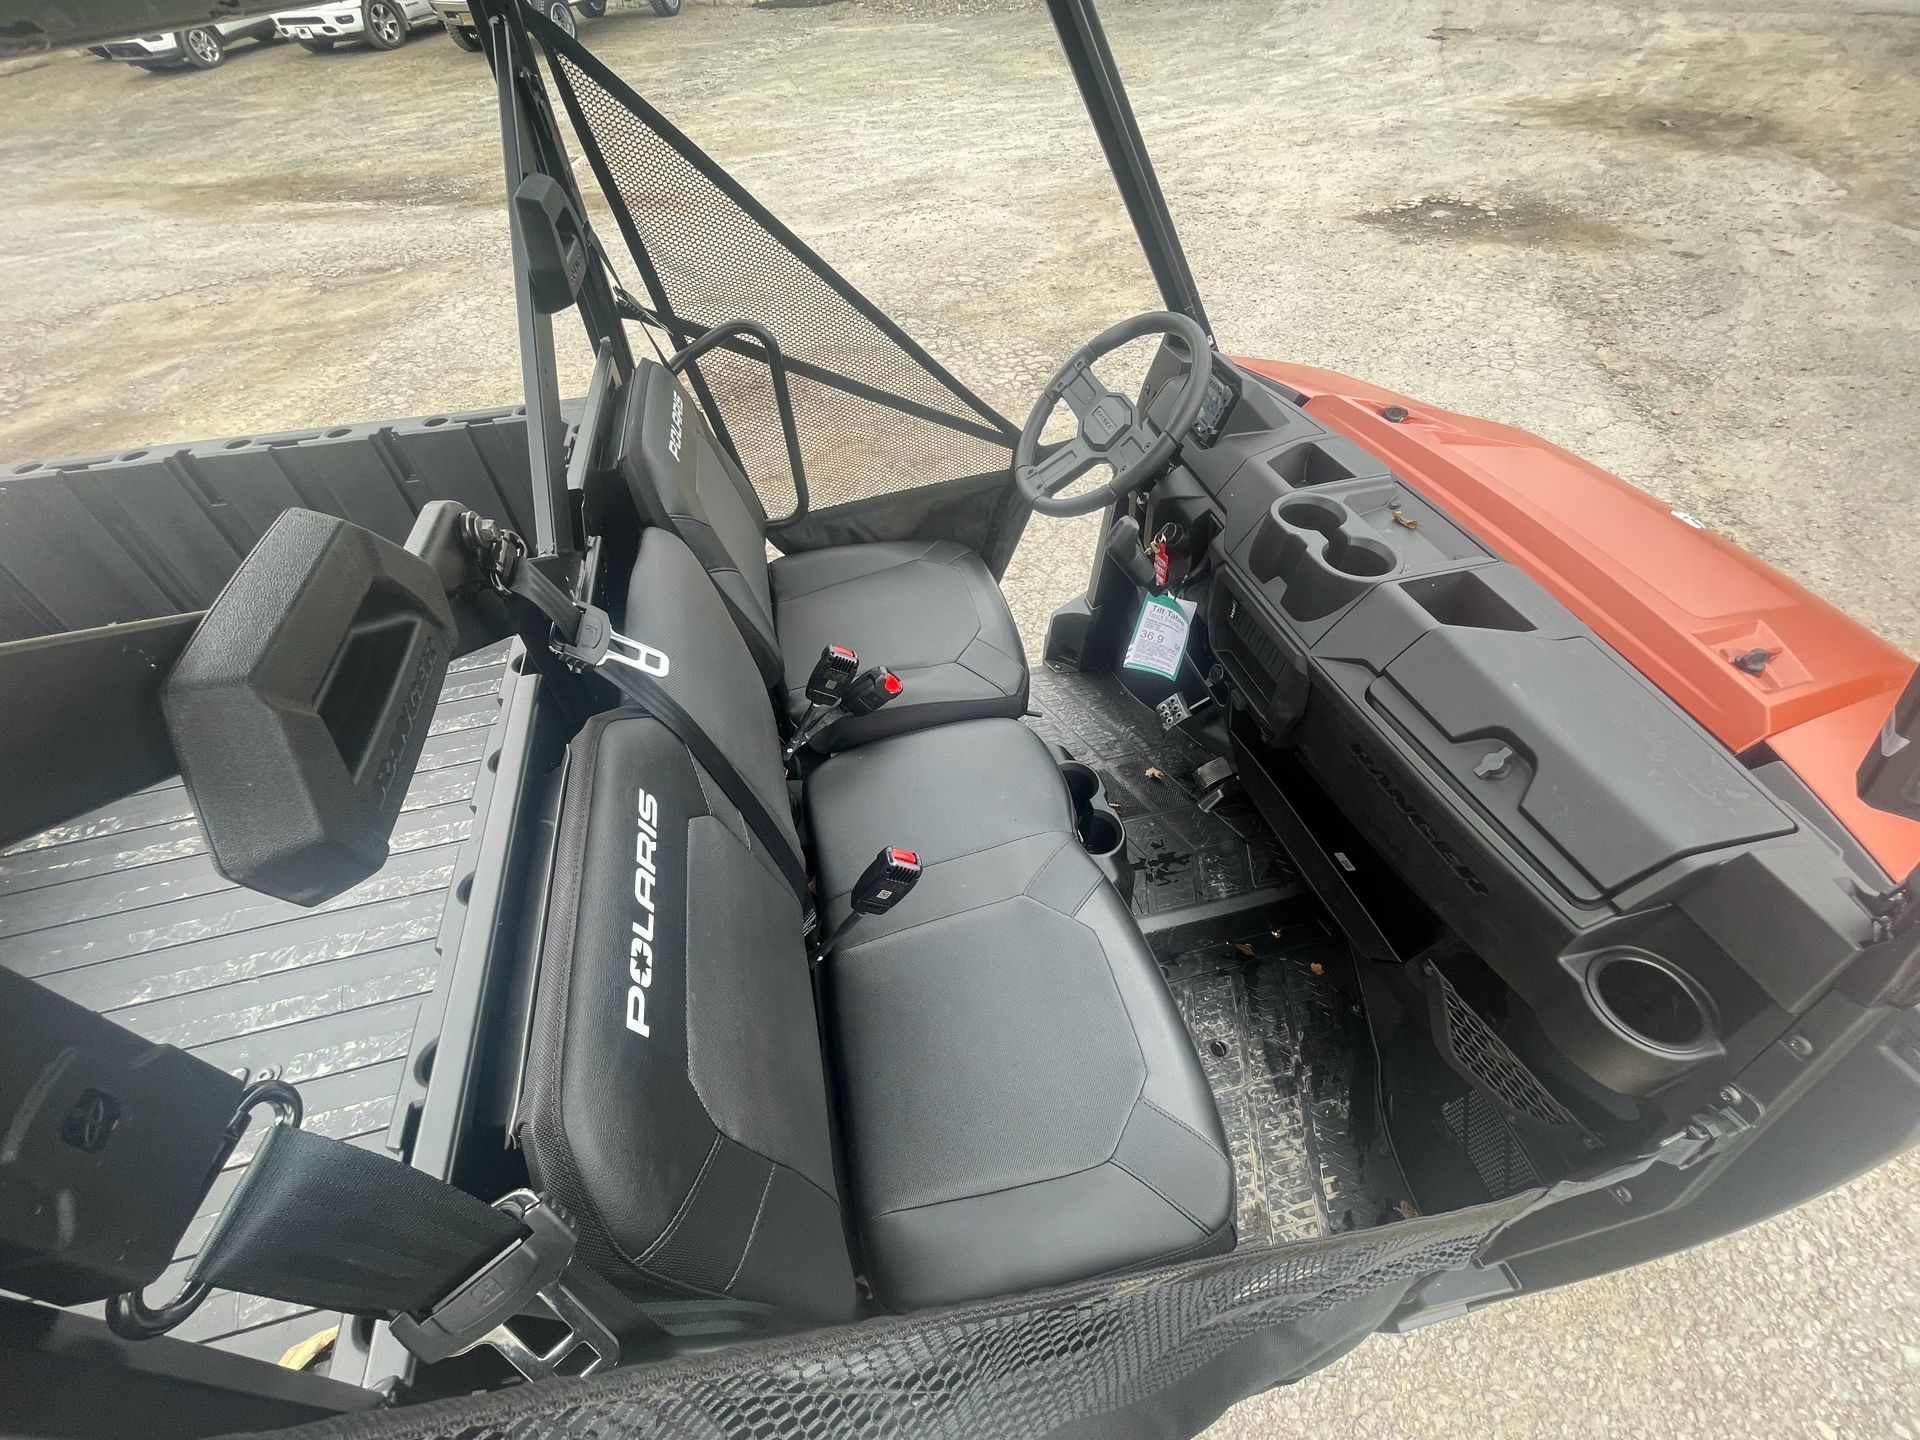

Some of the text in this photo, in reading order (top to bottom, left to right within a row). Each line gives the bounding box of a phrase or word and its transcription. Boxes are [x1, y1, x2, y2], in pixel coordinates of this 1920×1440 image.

[668, 390, 684, 463] POLARIS
[1140, 629, 1164, 644] 36.9
[1148, 611, 1164, 621] Test
[1152, 605, 1165, 615] Tilt
[1167, 610, 1185, 627] Table
[1346, 743, 1489, 897] RANGER
[626, 787, 658, 1039] POLARIS
